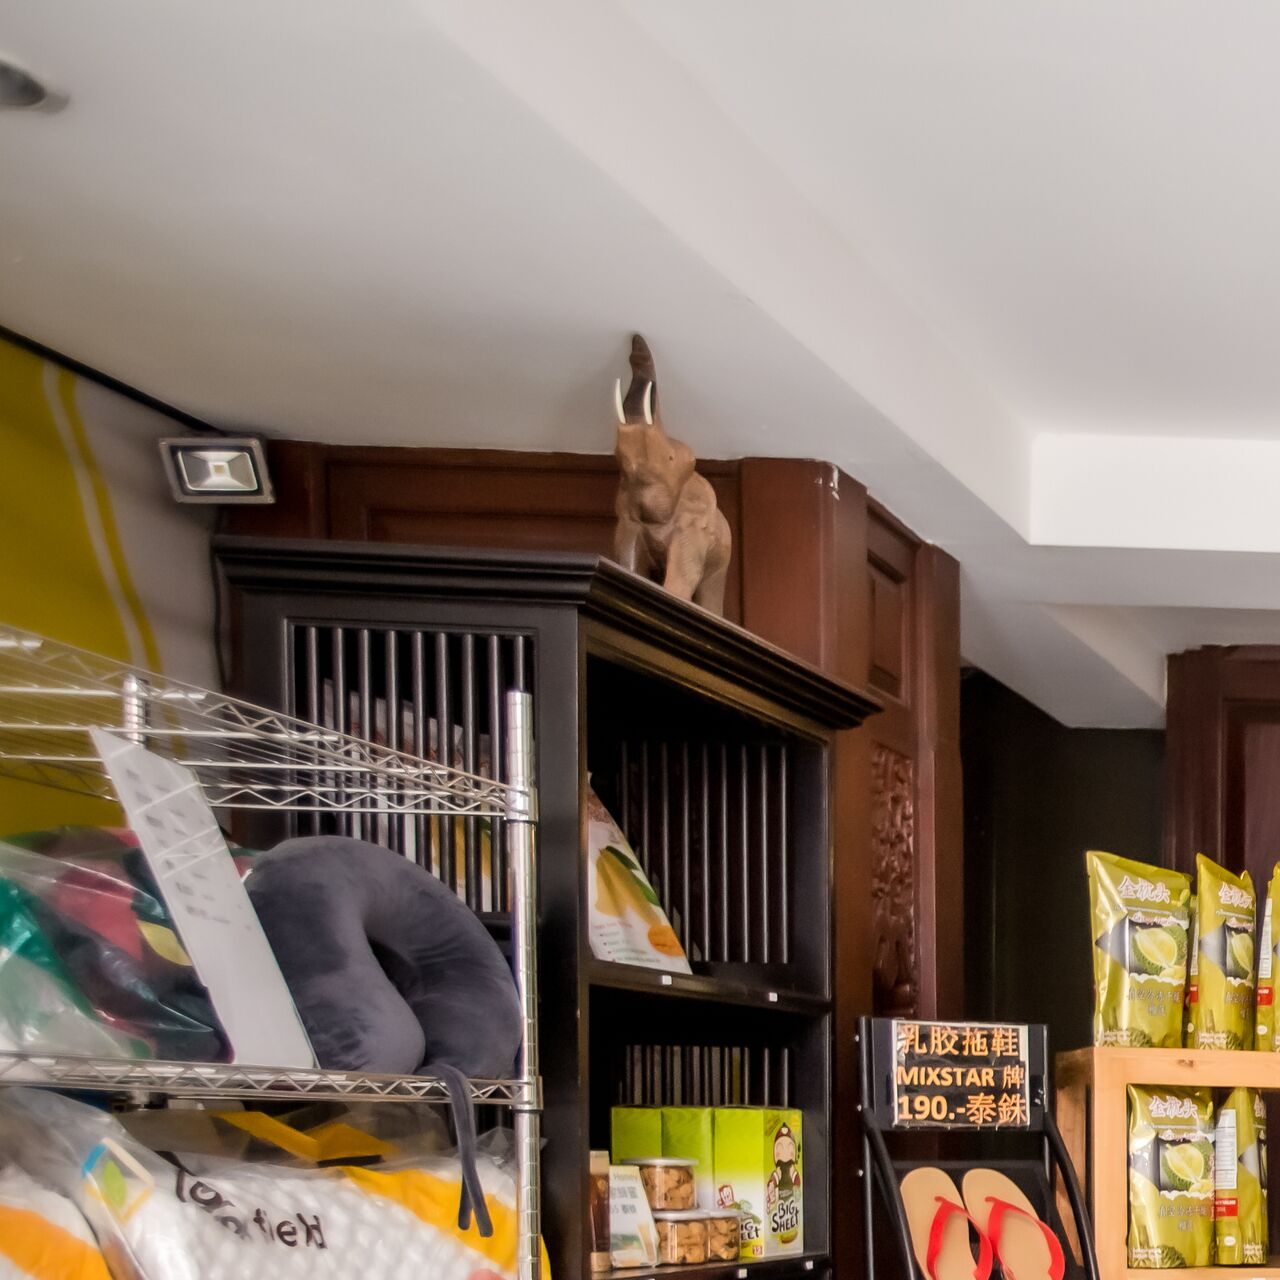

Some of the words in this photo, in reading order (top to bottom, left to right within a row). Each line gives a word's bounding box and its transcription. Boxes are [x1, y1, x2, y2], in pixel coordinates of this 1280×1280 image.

[1117, 875, 1171, 904] 金枕头
[899, 1024, 1020, 1058] 乳胶拖鞋
[897, 1066, 995, 1087] MIXSTAR
[1002, 1065, 1025, 1090] 牌
[1148, 1095, 1199, 1119] 金枕头
[777, 1199, 796, 1218] BIG
